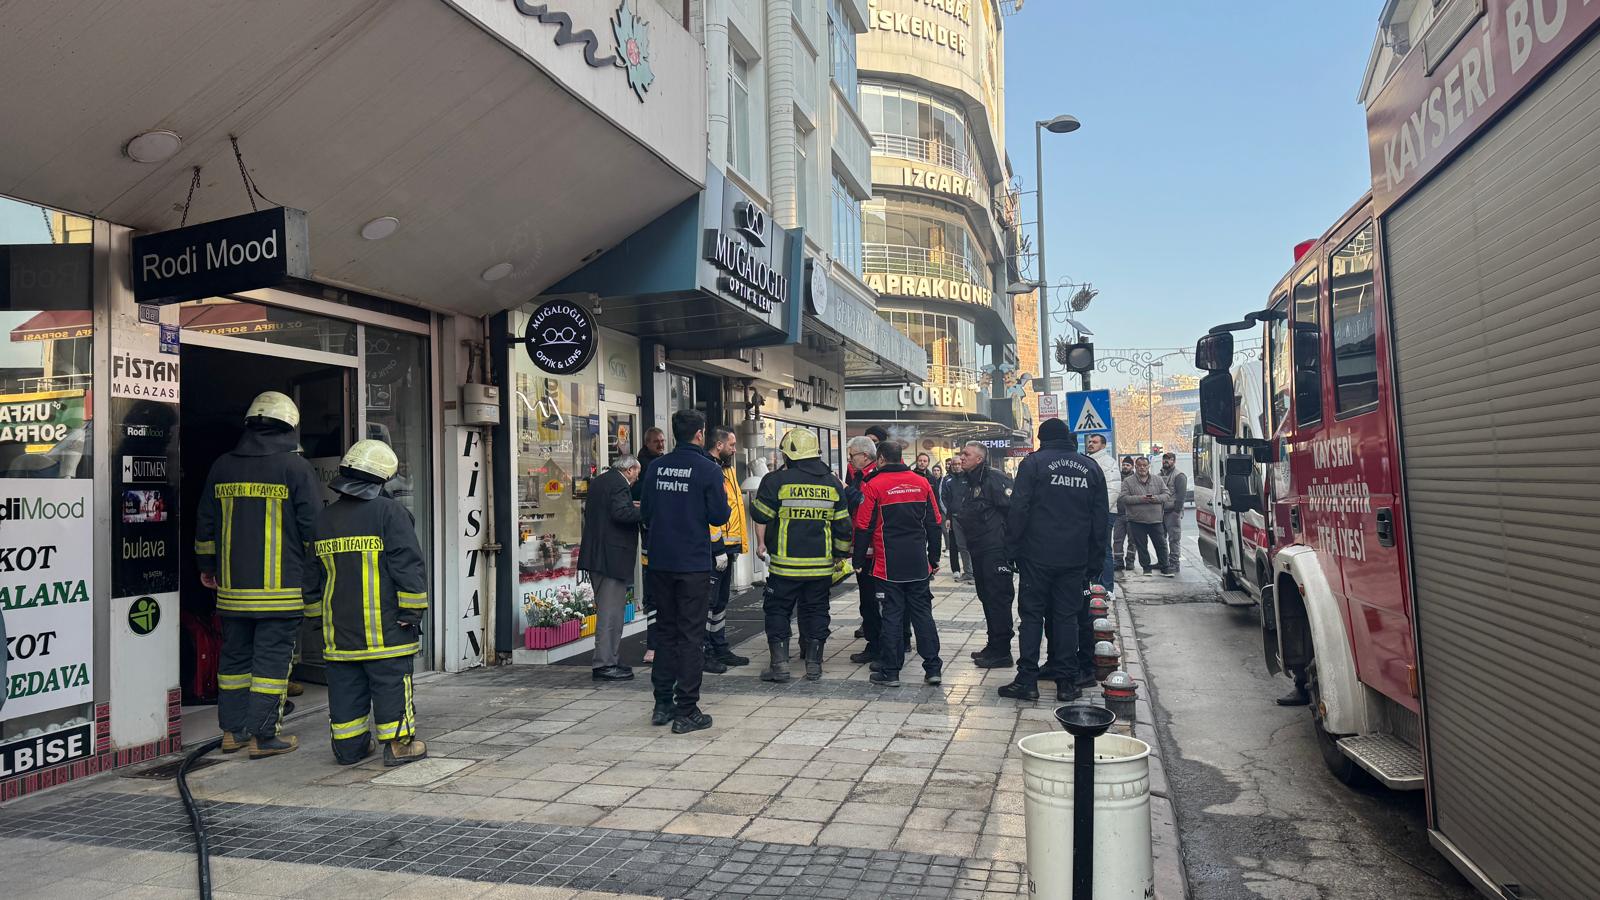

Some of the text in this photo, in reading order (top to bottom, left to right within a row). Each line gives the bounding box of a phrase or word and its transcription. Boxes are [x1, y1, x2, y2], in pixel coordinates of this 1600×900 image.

[869, 1, 966, 55] İSKENDER
[1384, 14, 1496, 192] KAYSERİ
[903, 167, 974, 198] IZGARA
[143, 229, 278, 282] Rodi Mood
[947, 278, 992, 308] DÖNER
[532, 305, 587, 330] MUĞALOĞLU
[113, 352, 179, 383] FİSTAN
[536, 348, 582, 369] OPTİK & LENS
[899, 384, 965, 411] ÇORBA
[1313, 427, 1354, 470] KAYSERİ
[656, 478, 689, 492] İTFAİYE
[657, 467, 692, 478] KAYSERİ
[1050, 474, 1089, 489] ZABITA
[789, 486, 830, 499] KAYSERİ
[788, 507, 829, 519] İTFAİYE
[122, 536, 165, 560] bulava
[463, 431, 485, 660] FİSTAN
[1317, 519, 1367, 562] İTFAİYESİ
